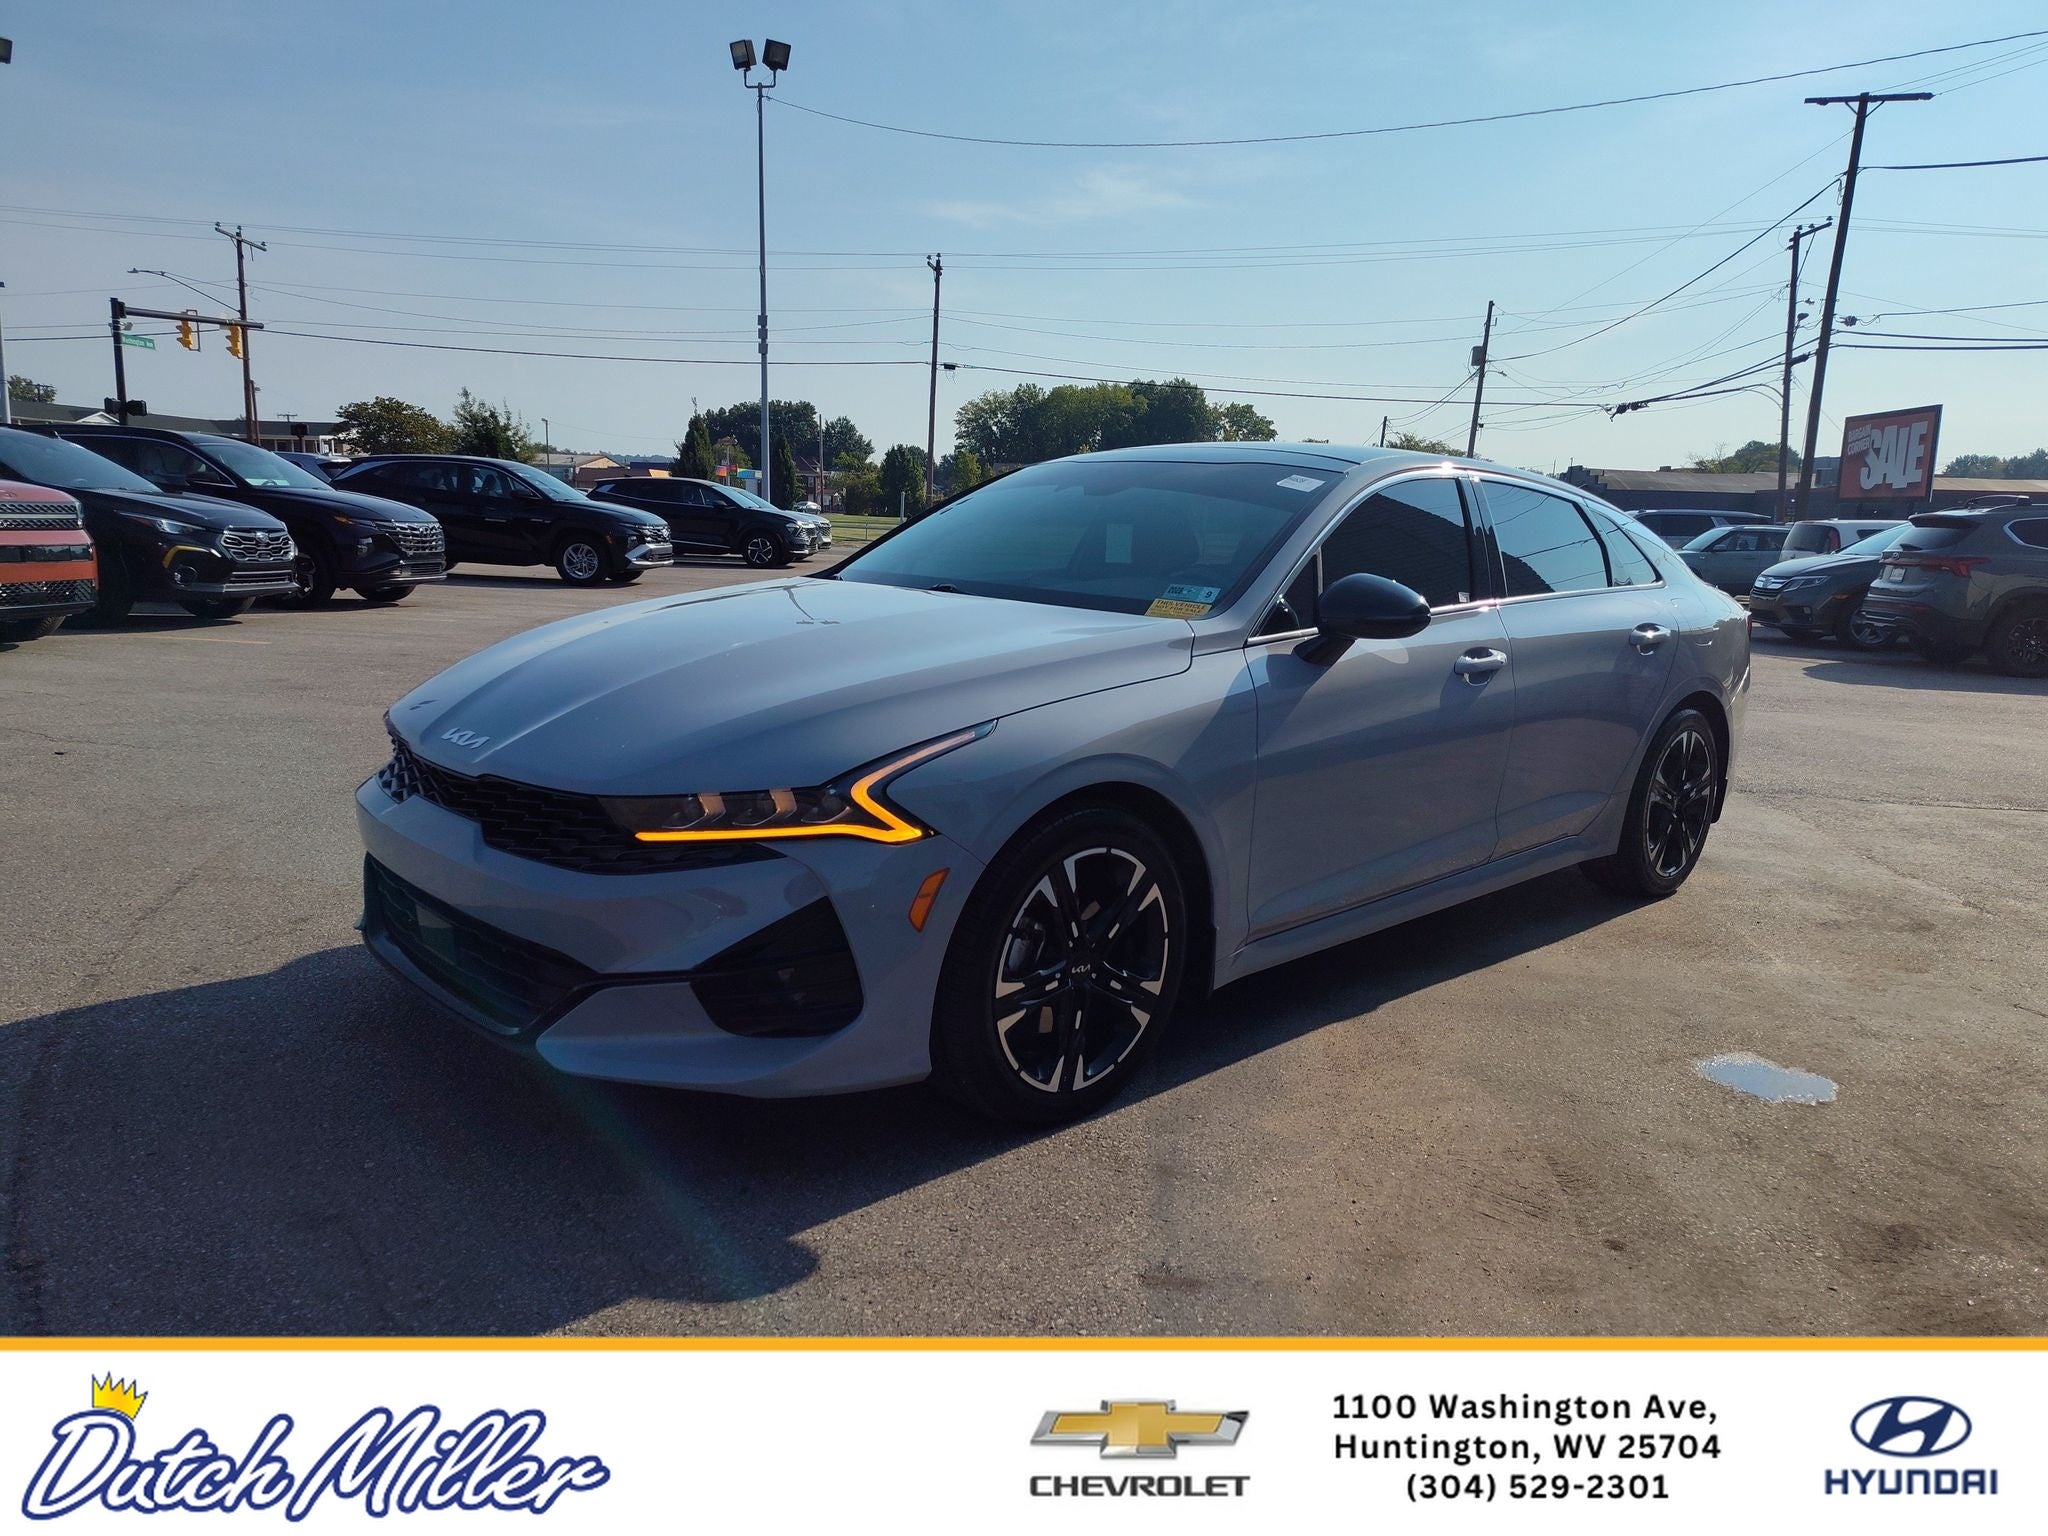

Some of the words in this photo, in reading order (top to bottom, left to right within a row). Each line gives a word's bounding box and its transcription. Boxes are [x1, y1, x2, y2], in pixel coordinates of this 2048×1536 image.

[1848, 424, 1872, 442] BARGAIN
[1847, 438, 1870, 455] CORNER
[1860, 421, 1929, 489] SALE
[1174, 601, 1206, 610] VEHICLE
[440, 727, 490, 749] KIA
